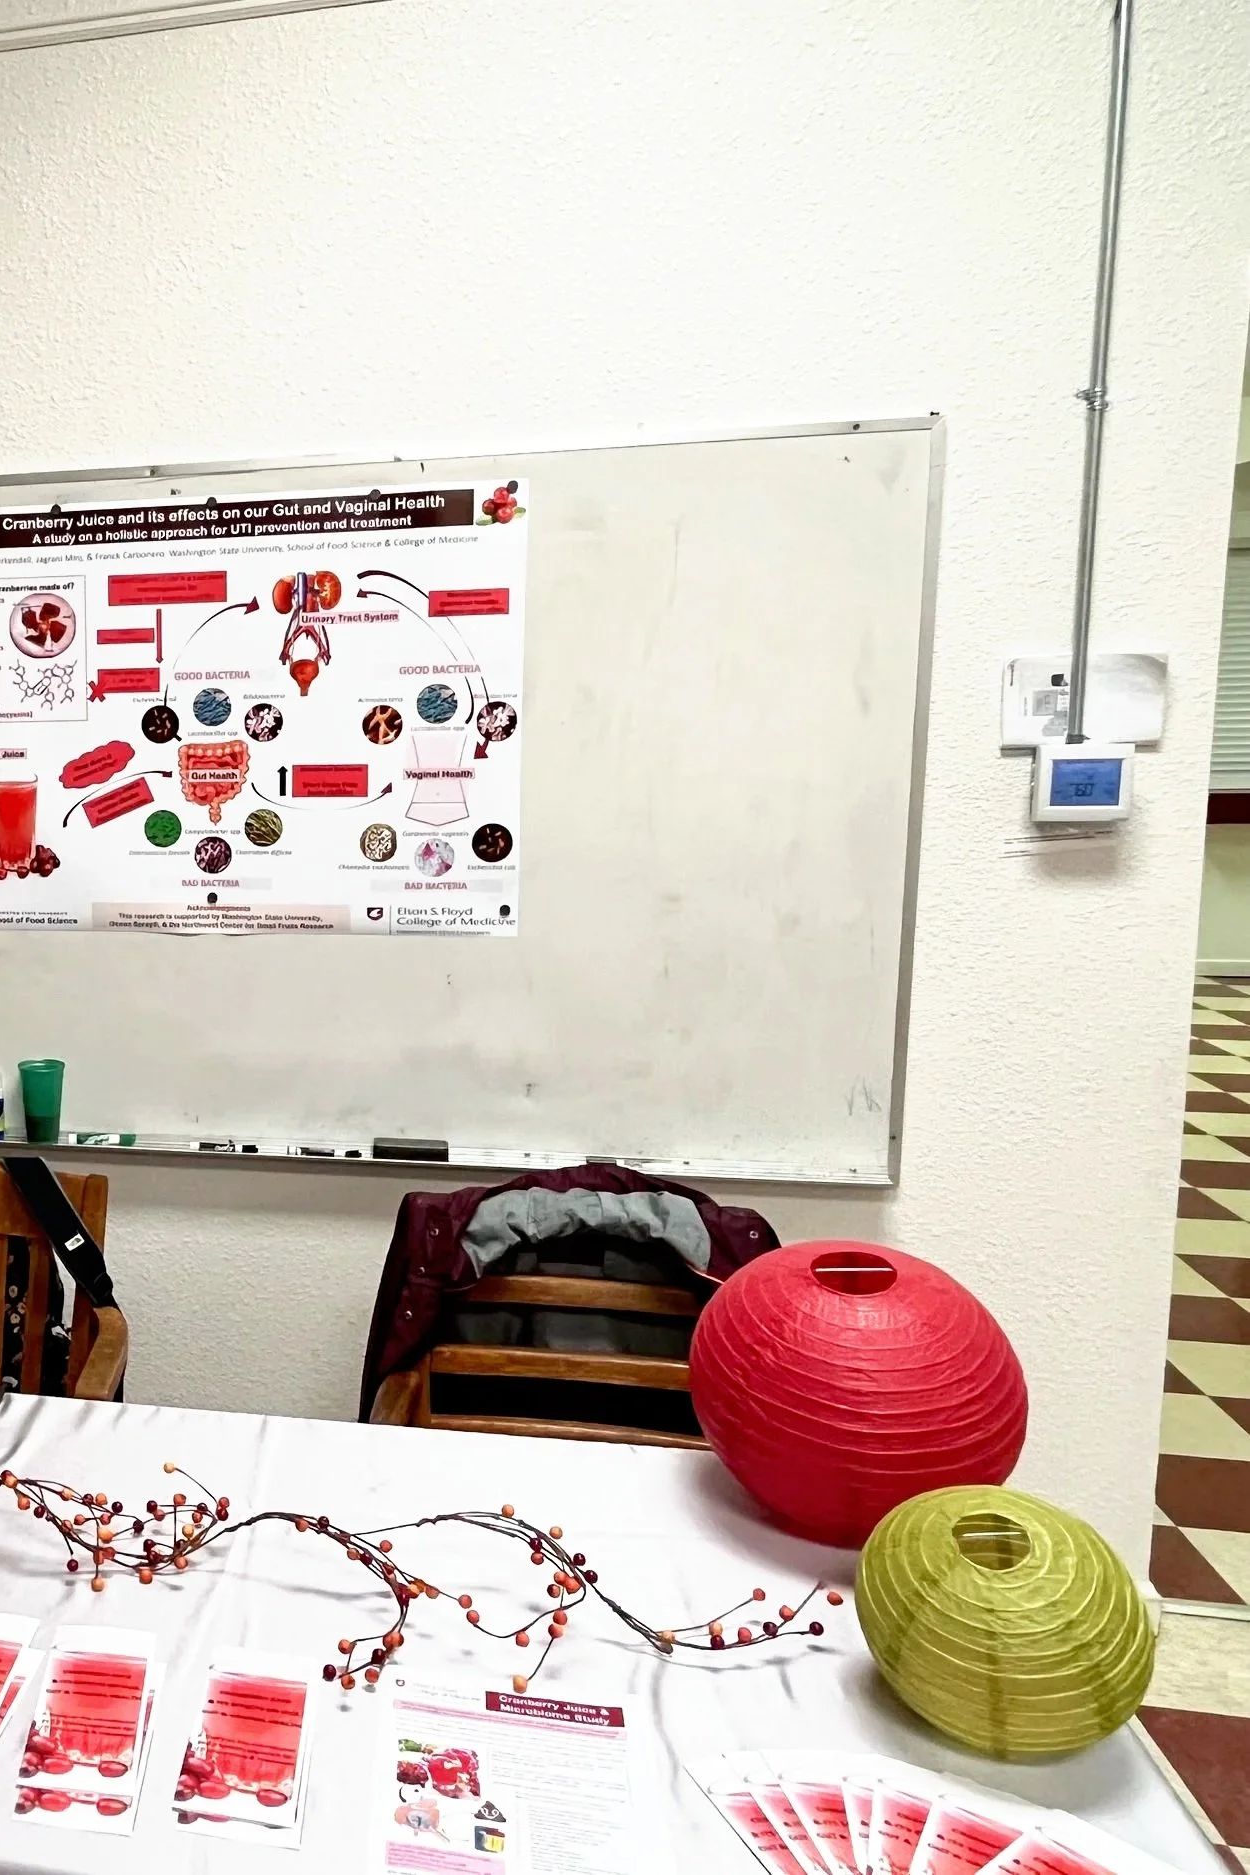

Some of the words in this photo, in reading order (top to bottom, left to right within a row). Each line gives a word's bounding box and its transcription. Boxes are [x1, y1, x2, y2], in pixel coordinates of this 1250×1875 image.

[2, 515, 73, 531] Cranberry
[76, 513, 114, 527] Juice
[118, 511, 144, 525] and
[147, 510, 165, 523] its
[169, 508, 219, 522] effects
[223, 508, 241, 520] on
[244, 506, 269, 518] our
[272, 503, 300, 517] Gut
[304, 501, 331, 514] and
[335, 497, 391, 514] Vaginal
[395, 495, 445, 511] Health
[32, 534, 41, 544] A
[44, 532, 75, 546] study
[78, 532, 93, 542] on
[95, 533, 103, 541] a
[105, 528, 148, 541] holistic
[151, 525, 207, 540] approach
[210, 524, 227, 536] for
[230, 523, 252, 535] UTI
[254, 519, 320, 537] prevention
[323, 518, 347, 530] and
[350, 515, 412, 530] treatment
[87, 553, 93, 561] &
[169, 548, 217, 558] Washington
[219, 547, 240, 555] State
[287, 542, 314, 552] School
[316, 541, 325, 550] of
[327, 541, 348, 550] Food
[351, 540, 382, 549] Science
[385, 539, 391, 547] &
[394, 537, 425, 548] College
[427, 537, 436, 545] of
[438, 535, 478, 544] Medicine
[62, 582, 75, 590] of?
[301, 614, 335, 624] Urinary
[339, 613, 362, 623] Tract
[364, 612, 399, 622] System
[400, 665, 430, 675] GOOD
[433, 664, 481, 674] BACTERIA
[174, 672, 203, 681] GOOD
[205, 670, 250, 680] BACTERIA
[2, 750, 25, 759] Juice
[191, 772, 207, 780] Gut
[209, 772, 238, 780] Health
[405, 770, 440, 780] Vaginal
[442, 769, 473, 779] Health
[182, 879, 198, 887] BAD
[201, 879, 240, 887] BACTERIA
[404, 882, 423, 890] BAD
[425, 882, 468, 890] BACTERIA
[441, 907, 473, 918] Floyd
[15, 916, 24, 924] of
[47, 917, 78, 925] Science
[396, 917, 442, 927] College
[445, 917, 457, 925] of
[461, 917, 516, 926] Medicine
[499, 1695, 559, 1710] Cranberry
[563, 1705, 597, 1715] Juice
[600, 1708, 610, 1716] &
[500, 1704, 570, 1720] Microbiome
[574, 1714, 610, 1726] Study
